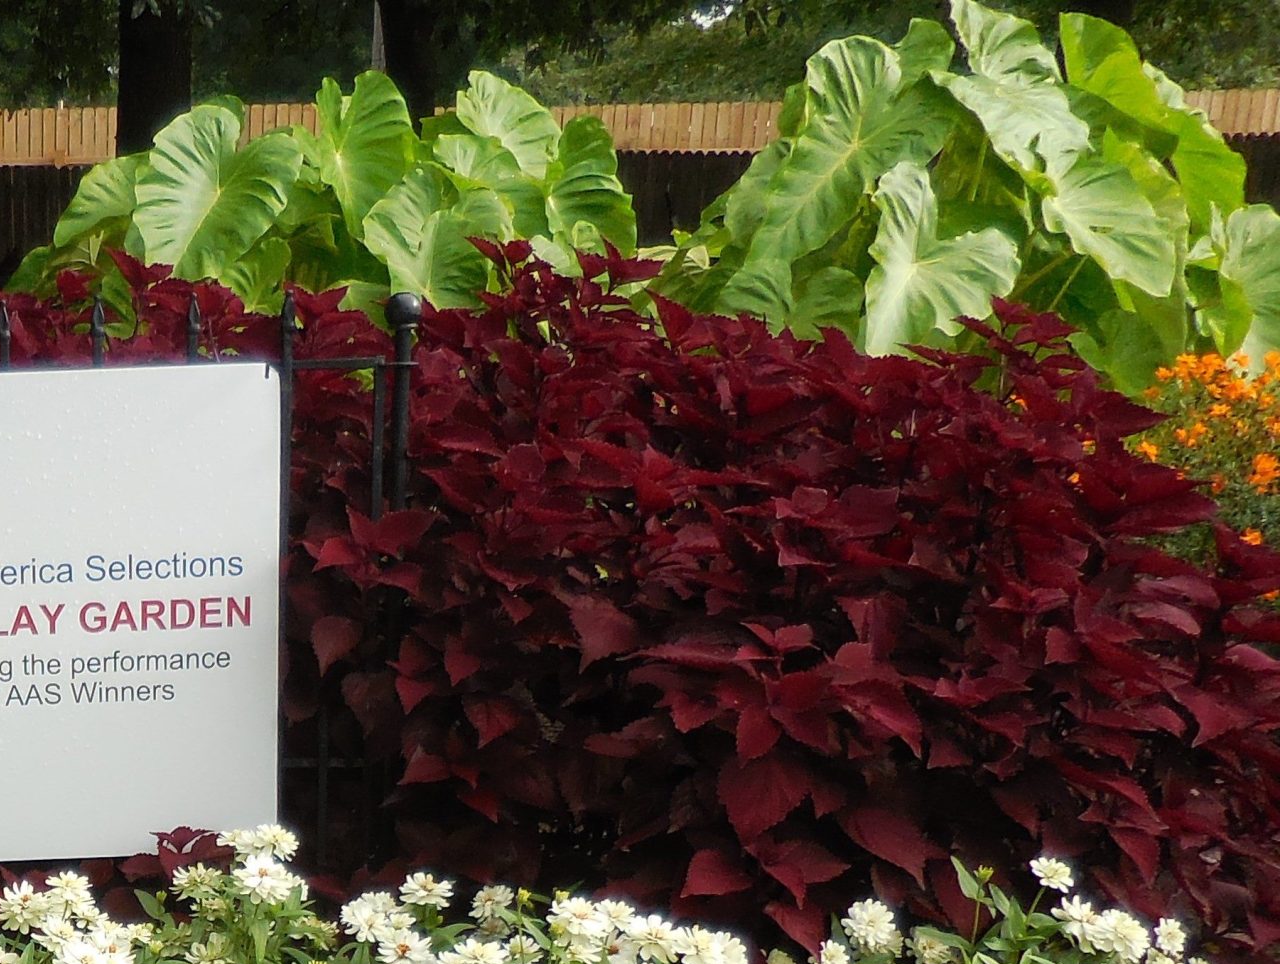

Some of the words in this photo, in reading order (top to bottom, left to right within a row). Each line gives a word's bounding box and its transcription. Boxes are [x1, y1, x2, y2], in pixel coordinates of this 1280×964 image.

[85, 551, 244, 582] Selections
[78, 595, 253, 634] GARDEN
[21, 651, 62, 677] the
[70, 647, 231, 680] performance
[5, 682, 62, 707] AAS
[69, 679, 175, 705] Winners
